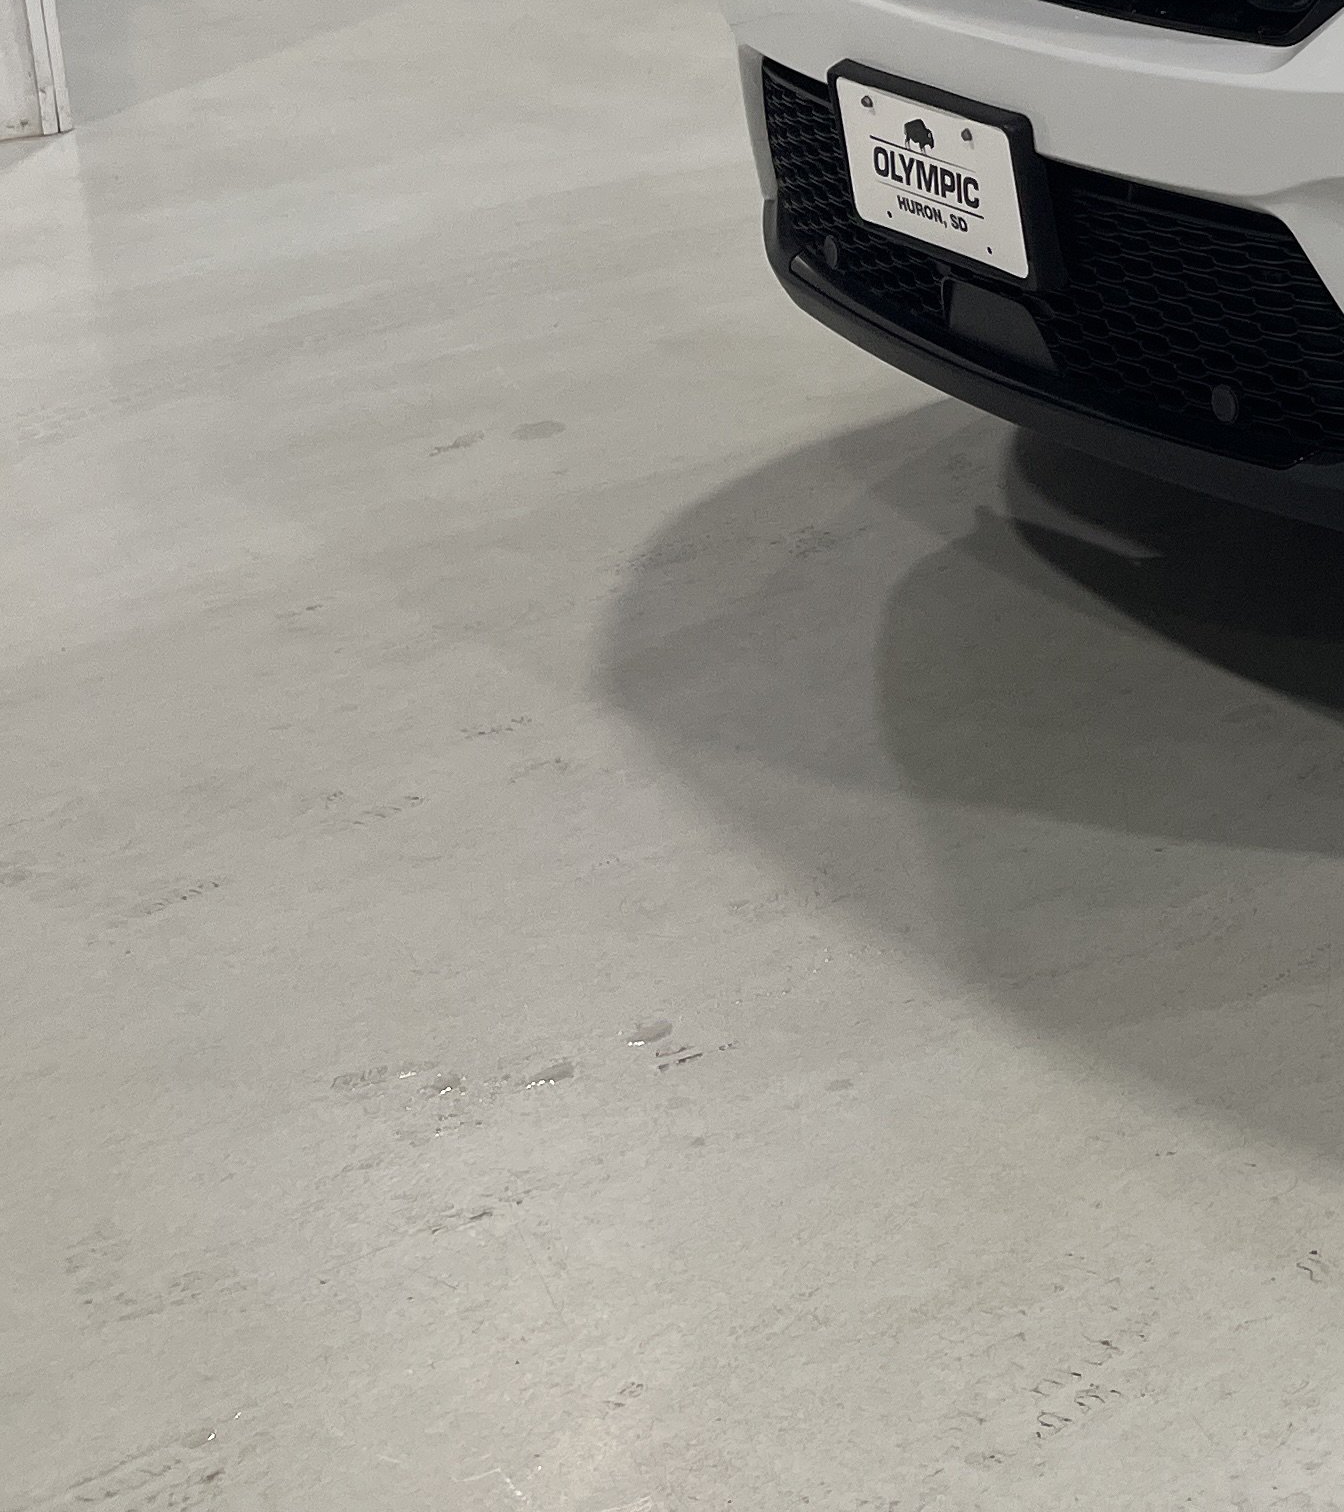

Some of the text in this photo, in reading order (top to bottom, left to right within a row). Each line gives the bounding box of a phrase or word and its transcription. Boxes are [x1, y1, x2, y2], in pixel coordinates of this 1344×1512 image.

[873, 145, 980, 209] OLYMPIC
[896, 194, 969, 233] HURON, SD
